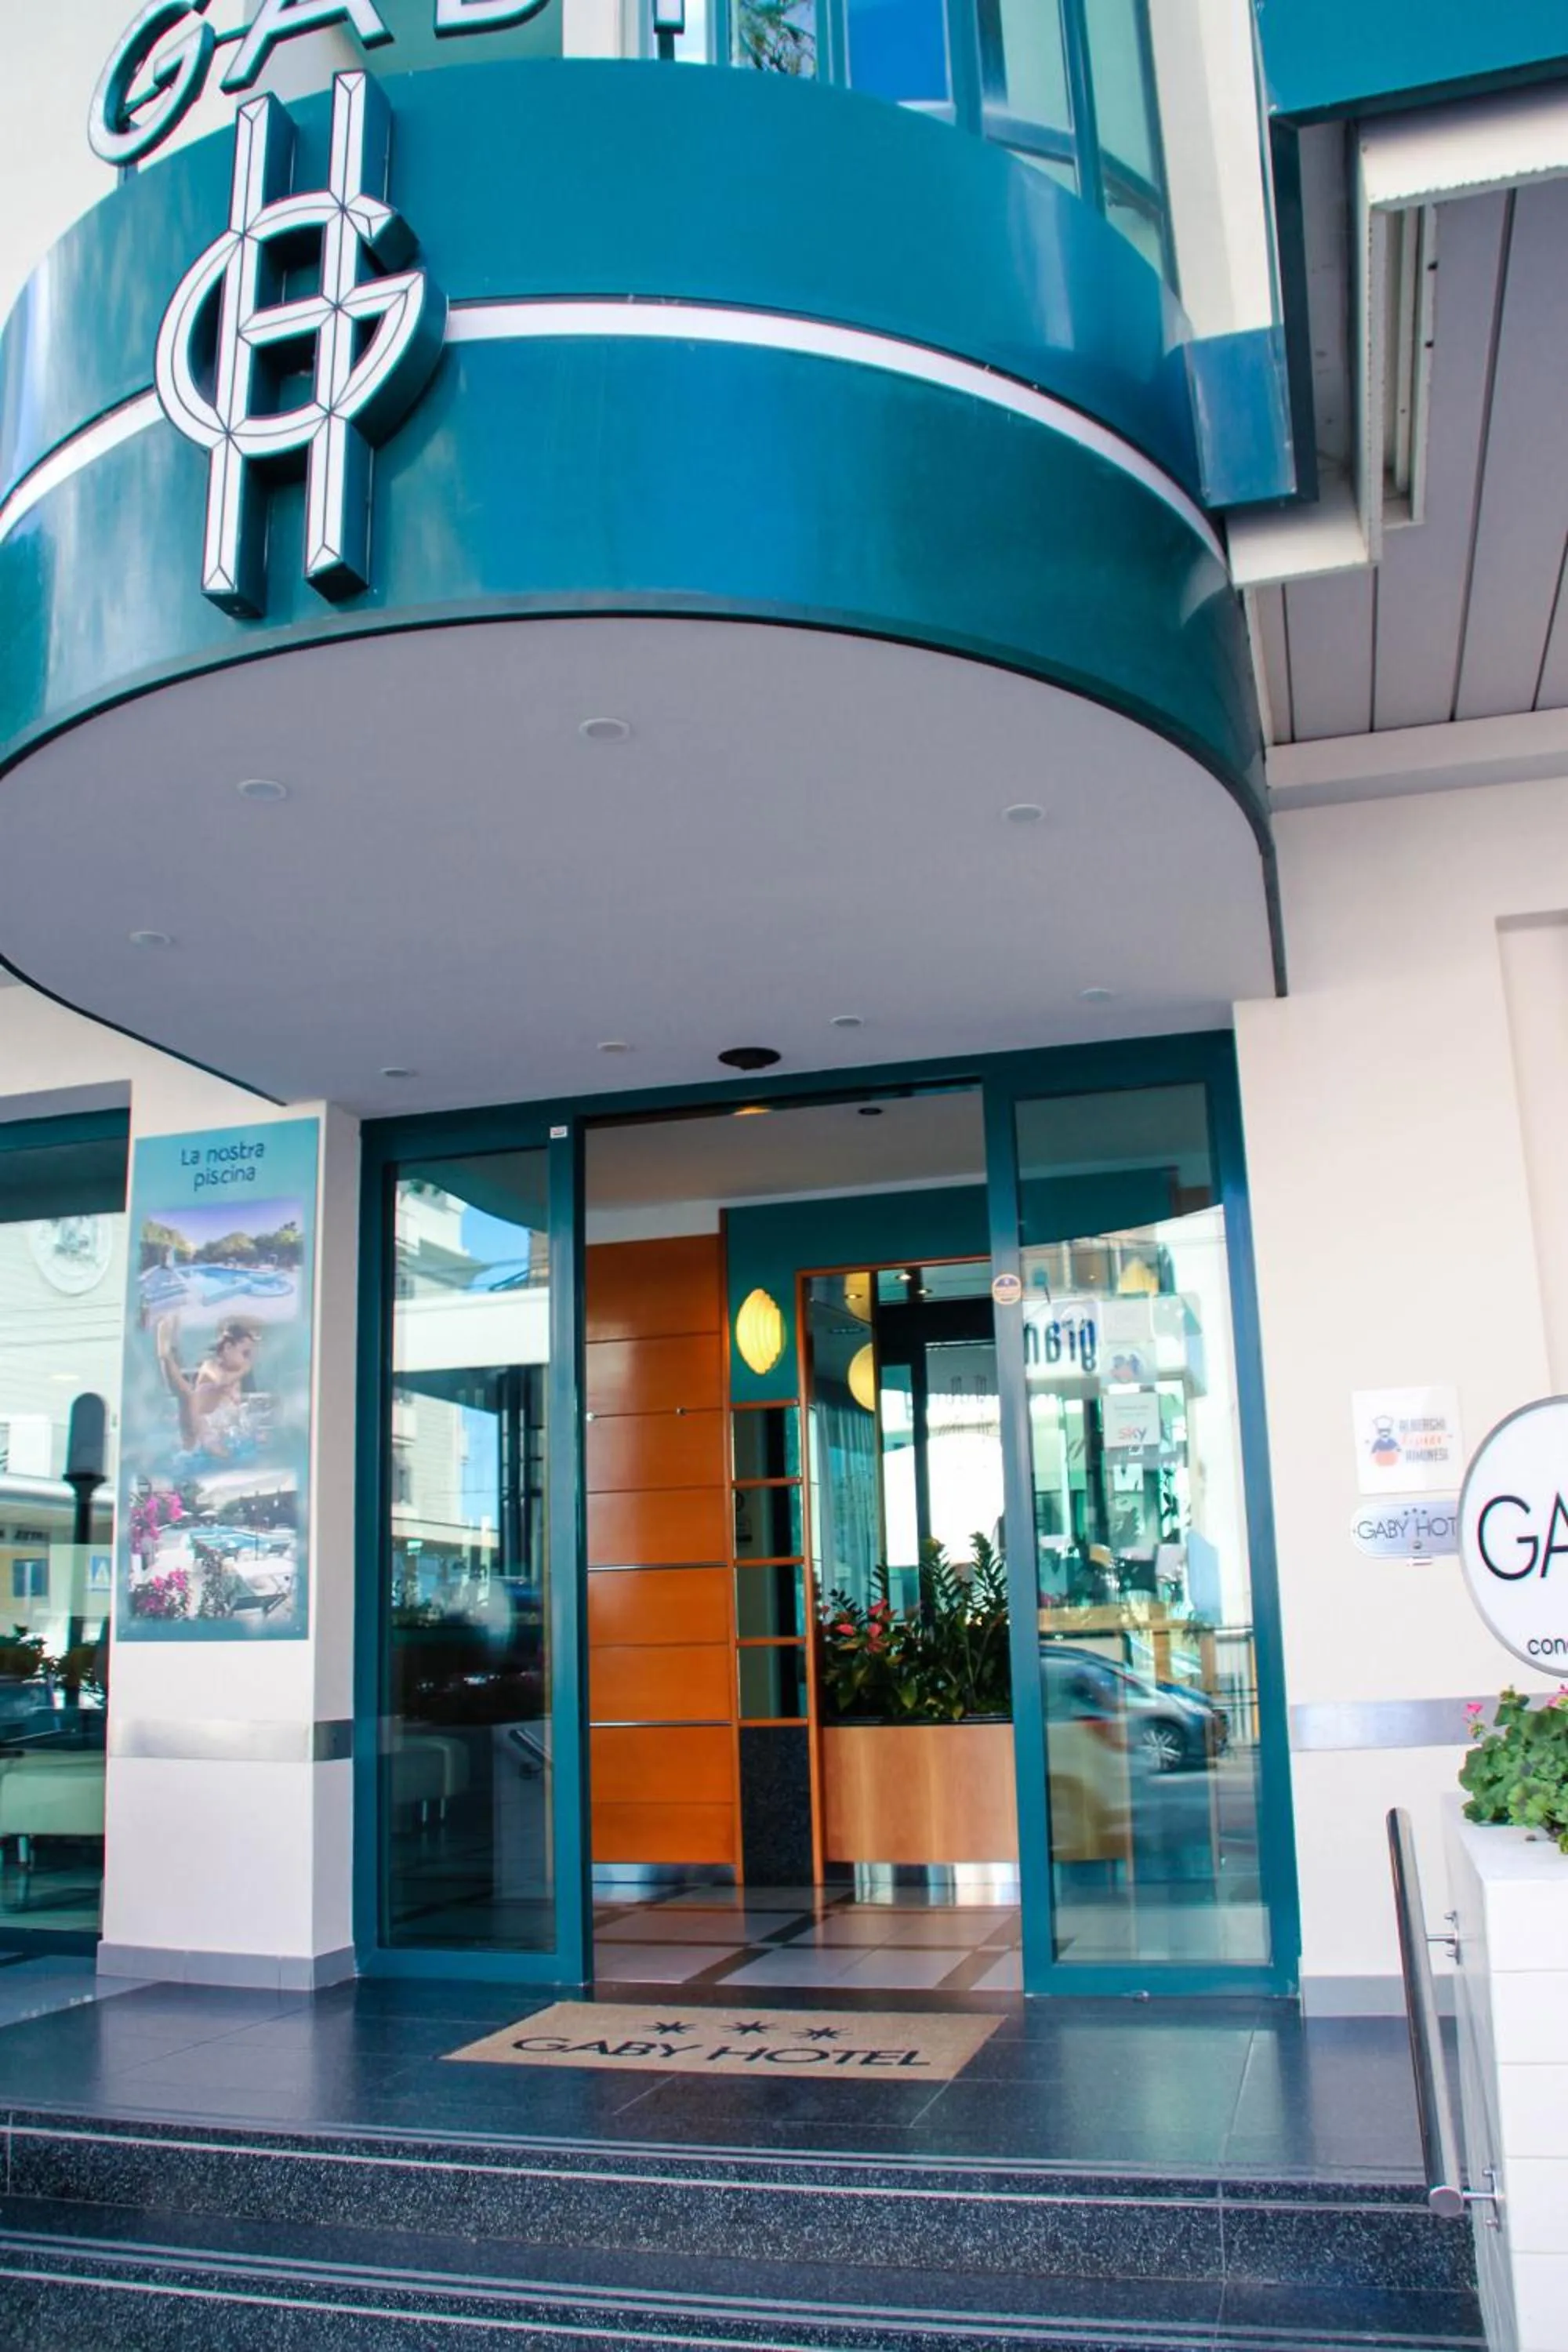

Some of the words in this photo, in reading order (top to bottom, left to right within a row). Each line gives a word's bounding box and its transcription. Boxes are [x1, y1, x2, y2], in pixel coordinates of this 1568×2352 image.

[88, 0, 685, 162] GA
[180, 1148, 201, 1167] La
[205, 1142, 265, 1163] nostra
[193, 1166, 256, 1192] piscina
[1118, 1425, 1147, 1443] sky
[1357, 1518, 1409, 1540] GABY
[1415, 1516, 1456, 1537] HOT
[1527, 1638, 1568, 1655] con
[513, 2036, 702, 2057] GABY
[706, 2045, 931, 2067] HOTEL
